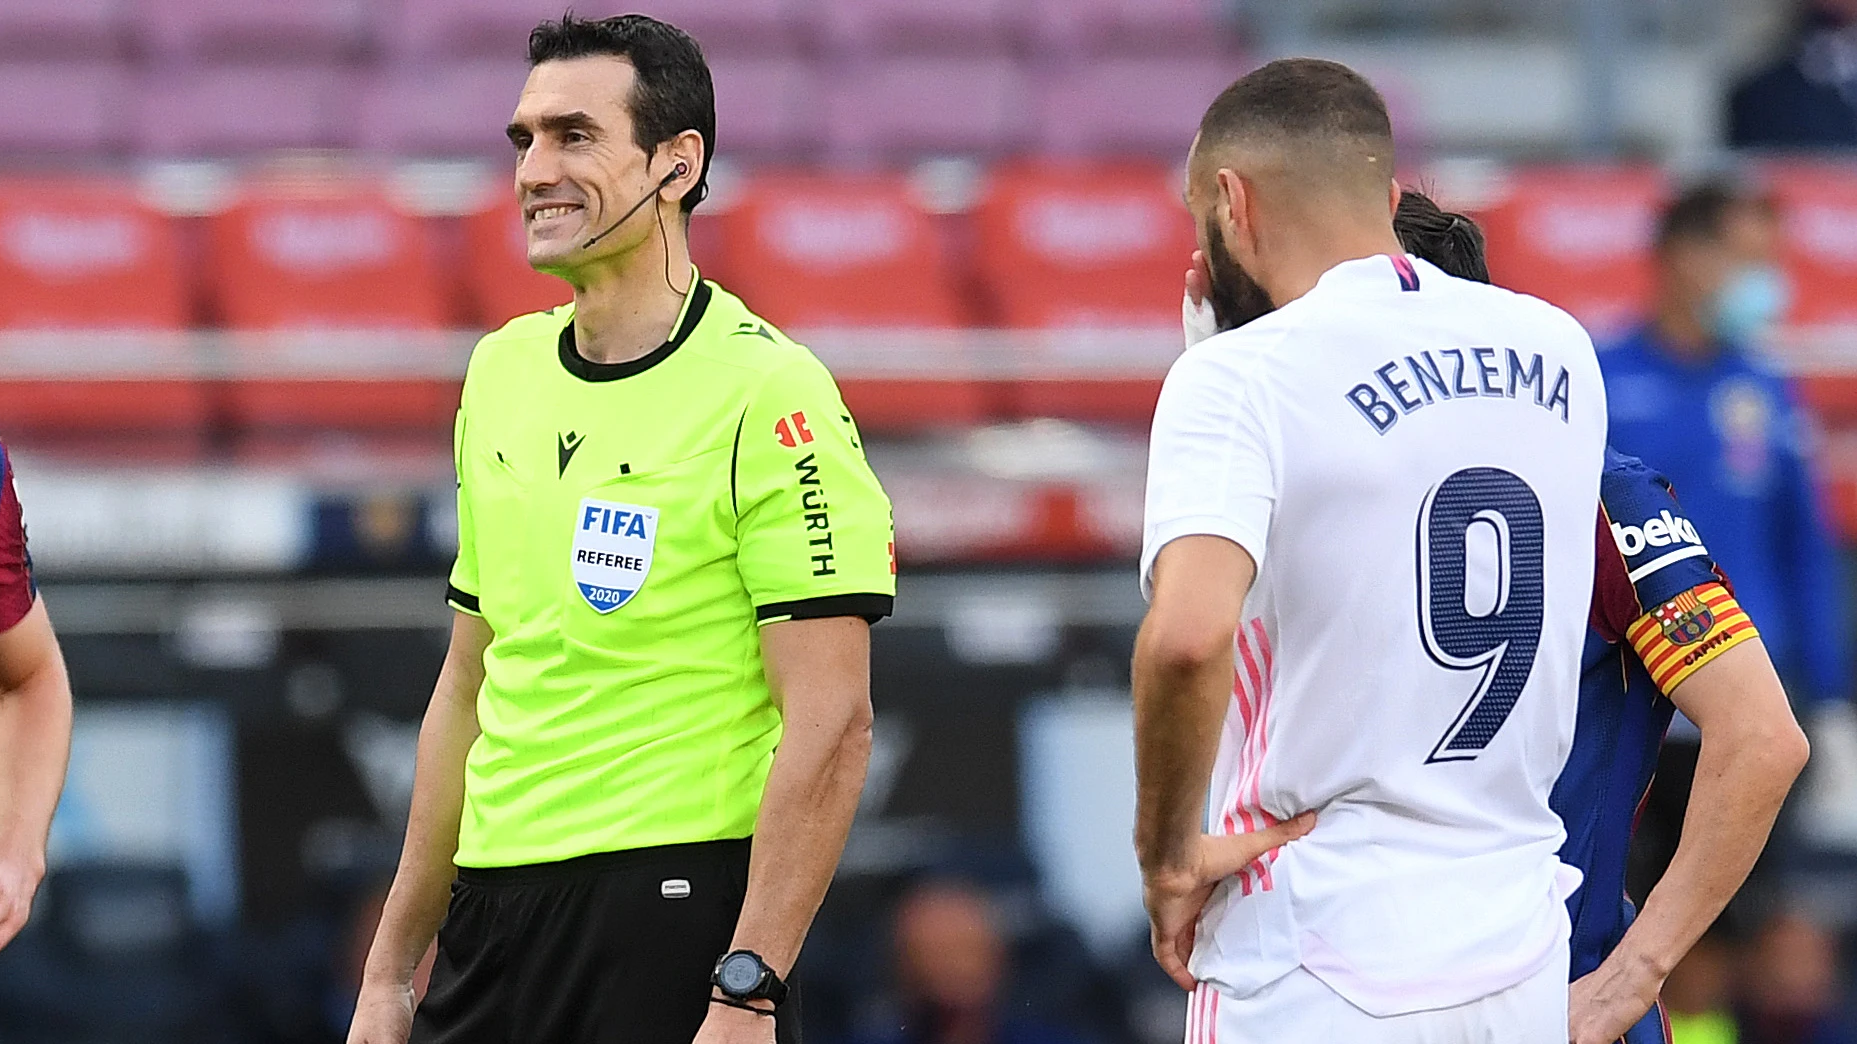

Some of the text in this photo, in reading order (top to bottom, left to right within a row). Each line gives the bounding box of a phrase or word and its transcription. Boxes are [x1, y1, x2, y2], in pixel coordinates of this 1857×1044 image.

[1345, 347, 1569, 436] BENZEMA
[582, 505, 647, 540] FIFA
[794, 452, 836, 577] WÜRTH
[1610, 509, 1703, 556] beko
[576, 549, 644, 572] REFEREE
[588, 586, 621, 605] 2020
[1416, 466, 1545, 764] 9
